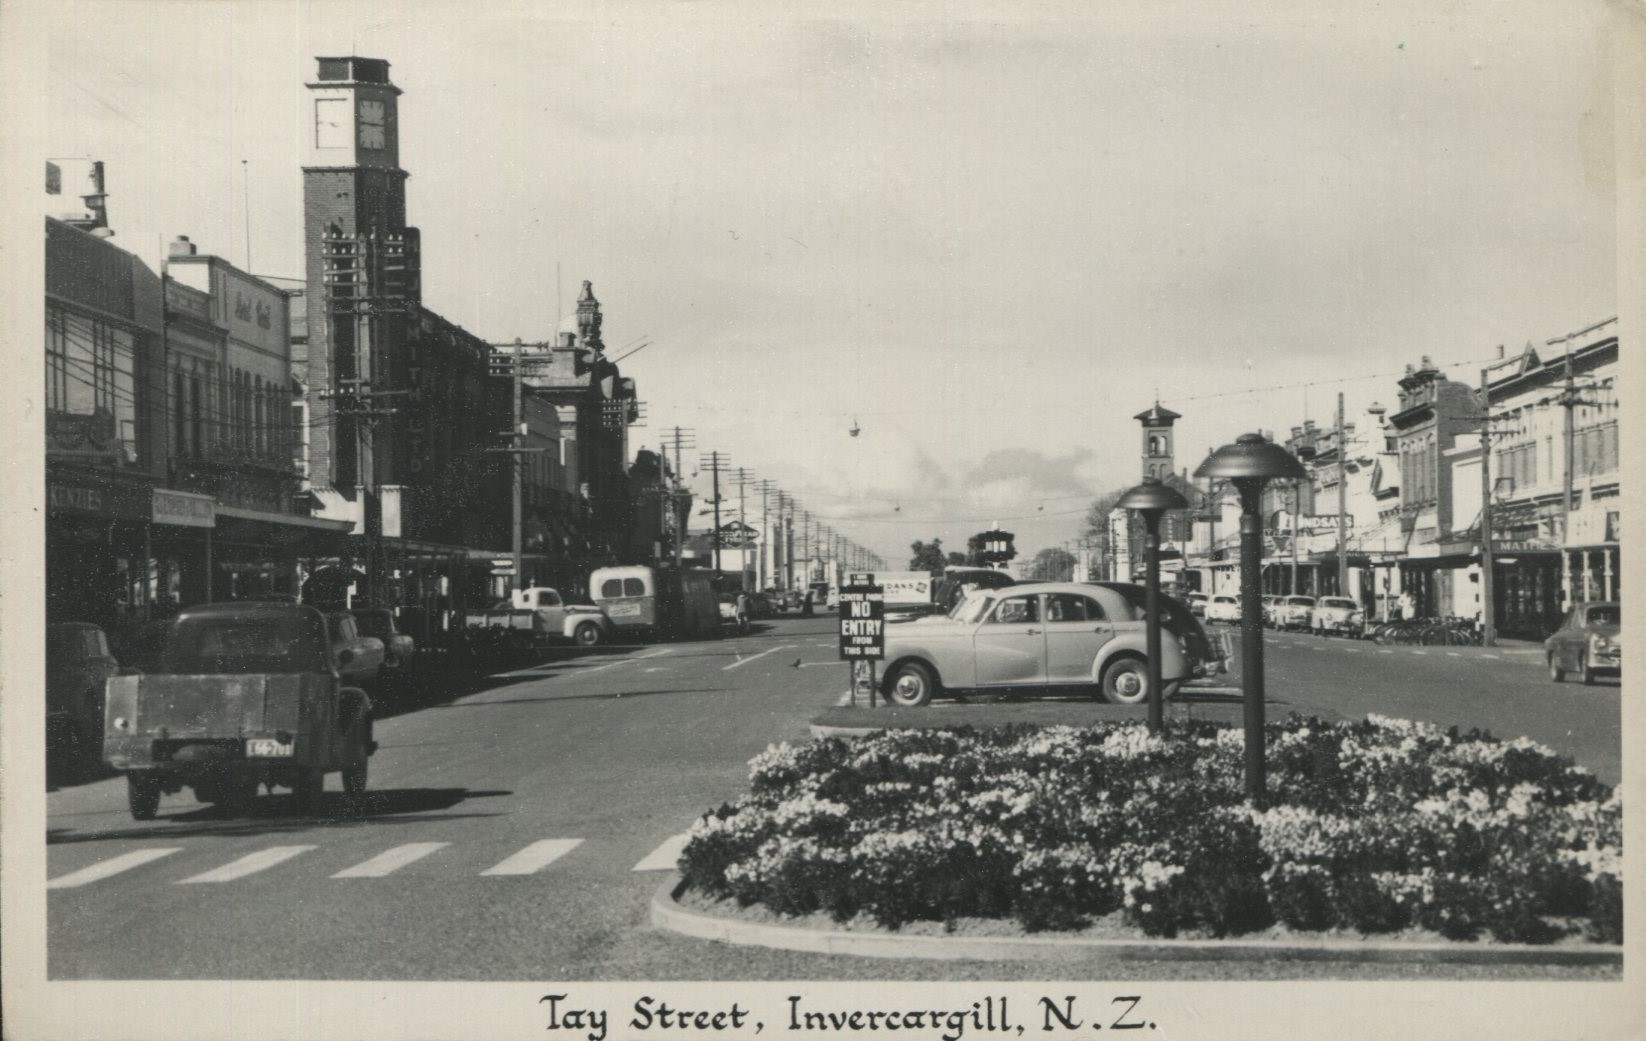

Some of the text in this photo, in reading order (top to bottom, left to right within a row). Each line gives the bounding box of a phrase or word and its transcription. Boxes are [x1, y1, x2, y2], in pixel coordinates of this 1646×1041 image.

[851, 602, 871, 617] NO
[842, 620, 882, 636] ENTRY
[844, 647, 881, 655] THIS SIDE
